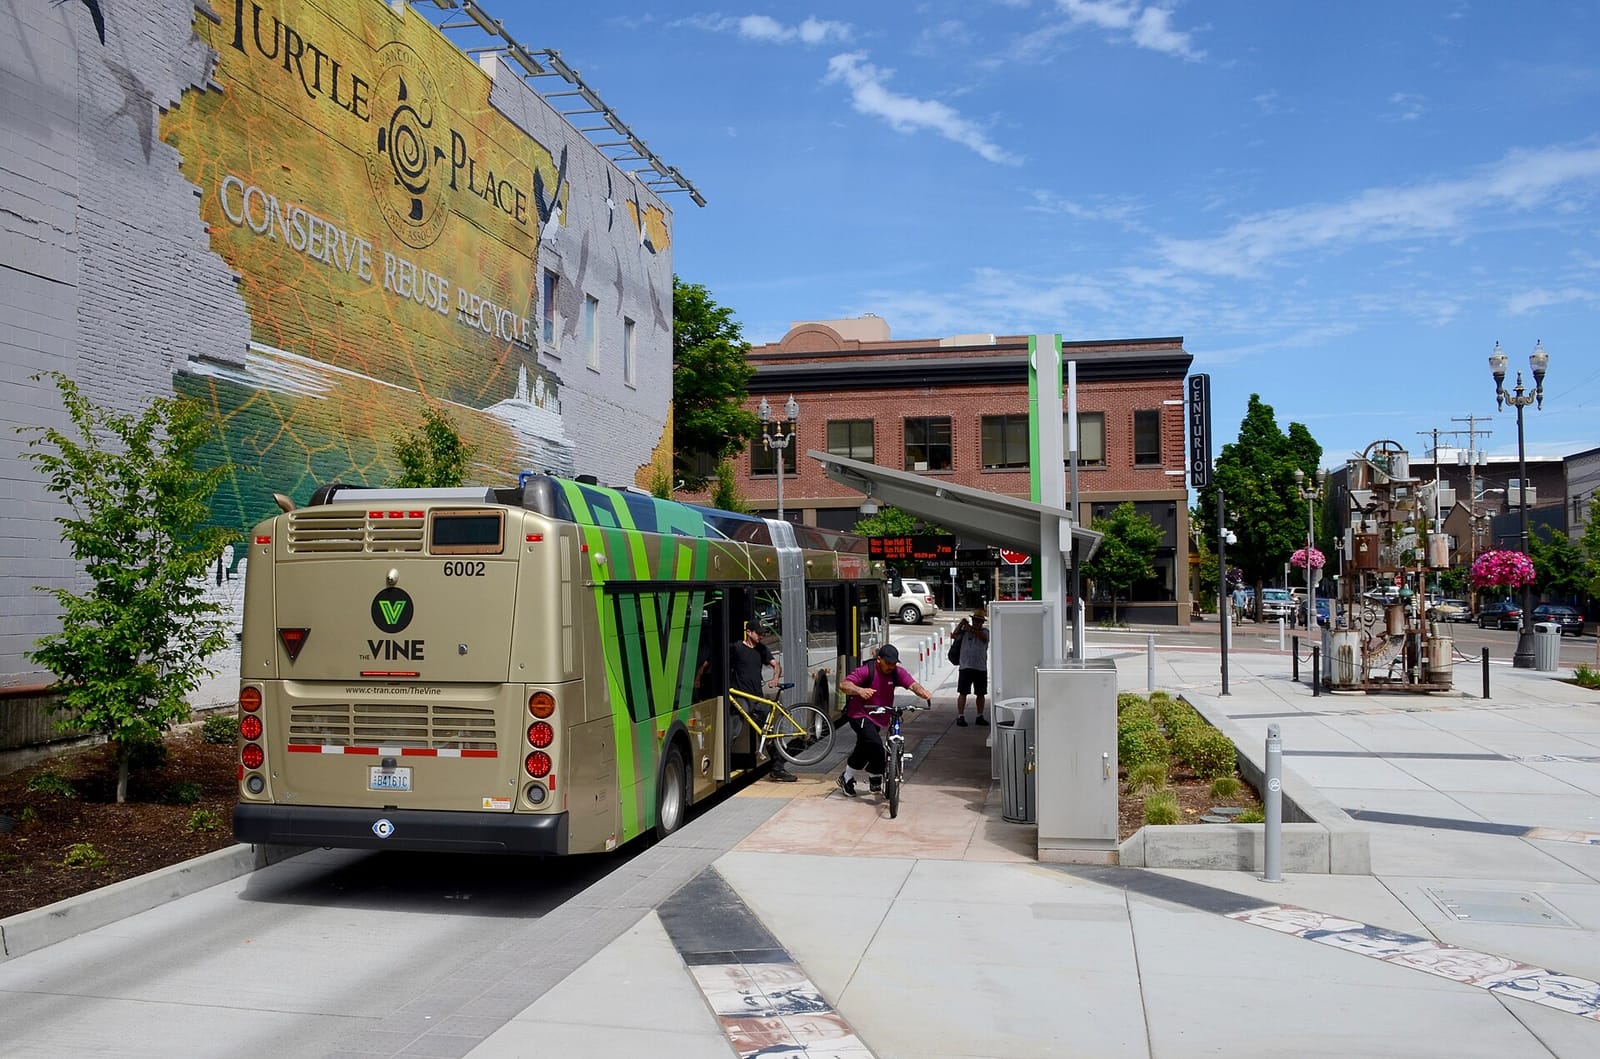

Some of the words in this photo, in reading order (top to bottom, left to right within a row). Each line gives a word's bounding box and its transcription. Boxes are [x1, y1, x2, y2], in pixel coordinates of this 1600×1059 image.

[449, 128, 527, 225] PLACE
[220, 175, 372, 283] CONSERVE
[384, 251, 449, 315] REUSE
[457, 287, 530, 351] RECYCLE
[1192, 378, 1204, 484] CENTURION
[443, 561, 486, 577] 6002
[367, 639, 425, 661] VINE
[345, 686, 442, 696] www.c-tran.com/TheVine
